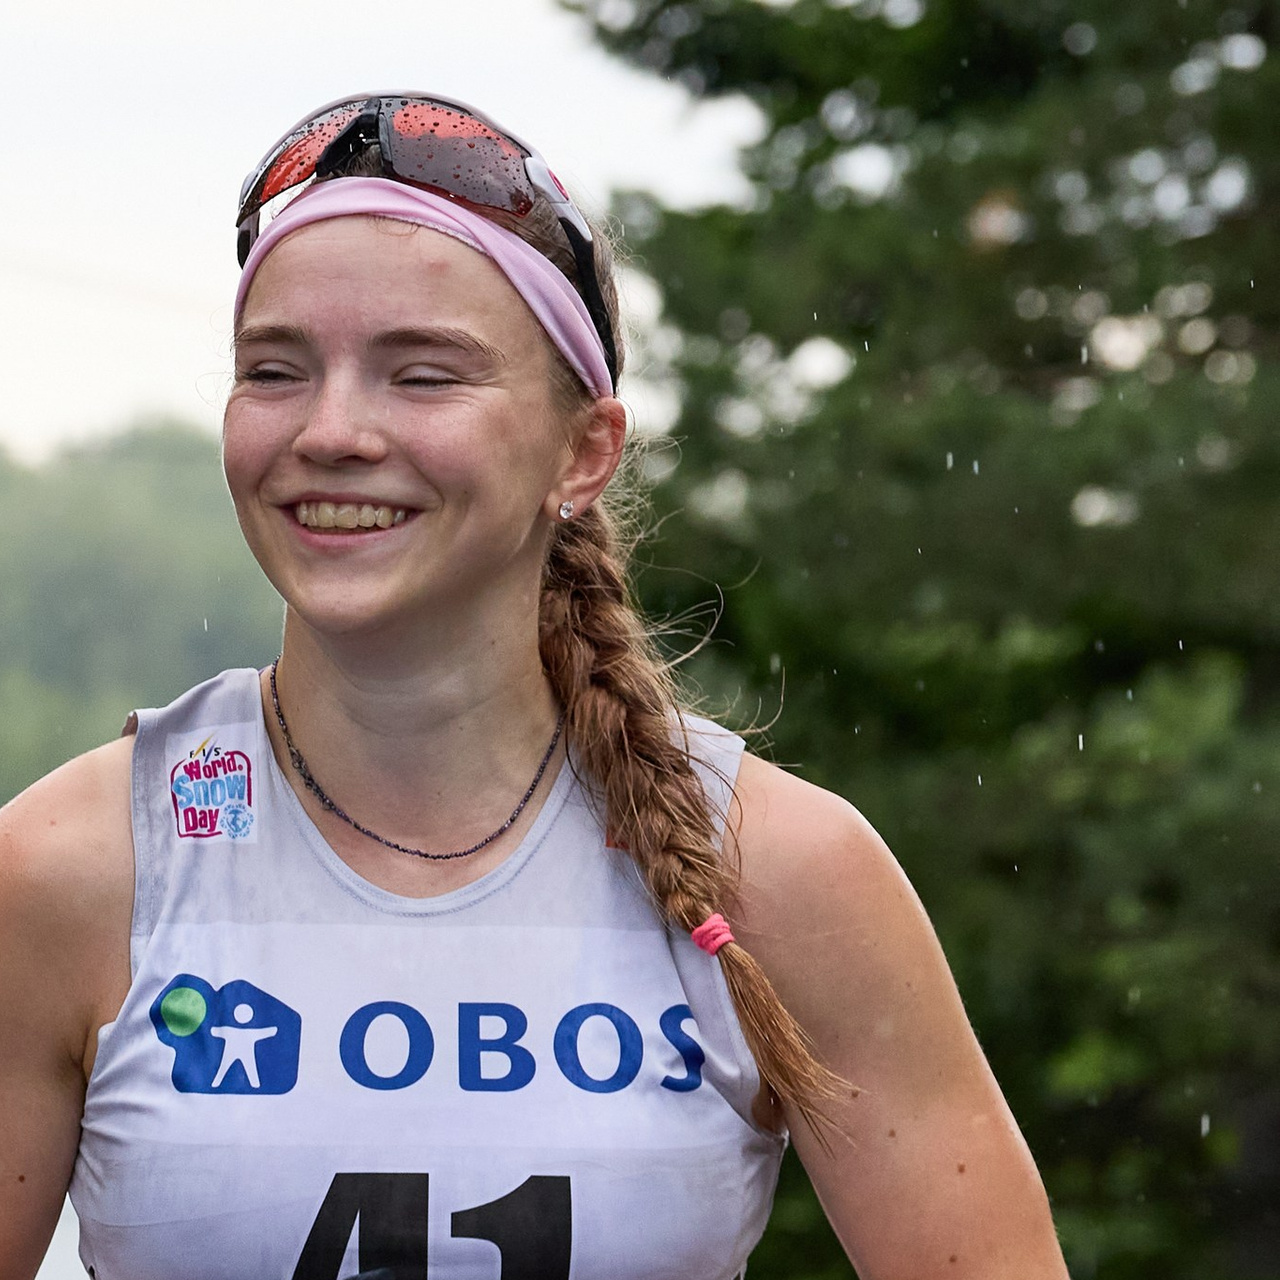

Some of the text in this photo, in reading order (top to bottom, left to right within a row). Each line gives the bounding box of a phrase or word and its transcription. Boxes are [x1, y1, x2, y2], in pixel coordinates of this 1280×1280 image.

[172, 774, 246, 809] Snow
[183, 806, 220, 832] Day
[339, 1001, 706, 1093] OBOS
